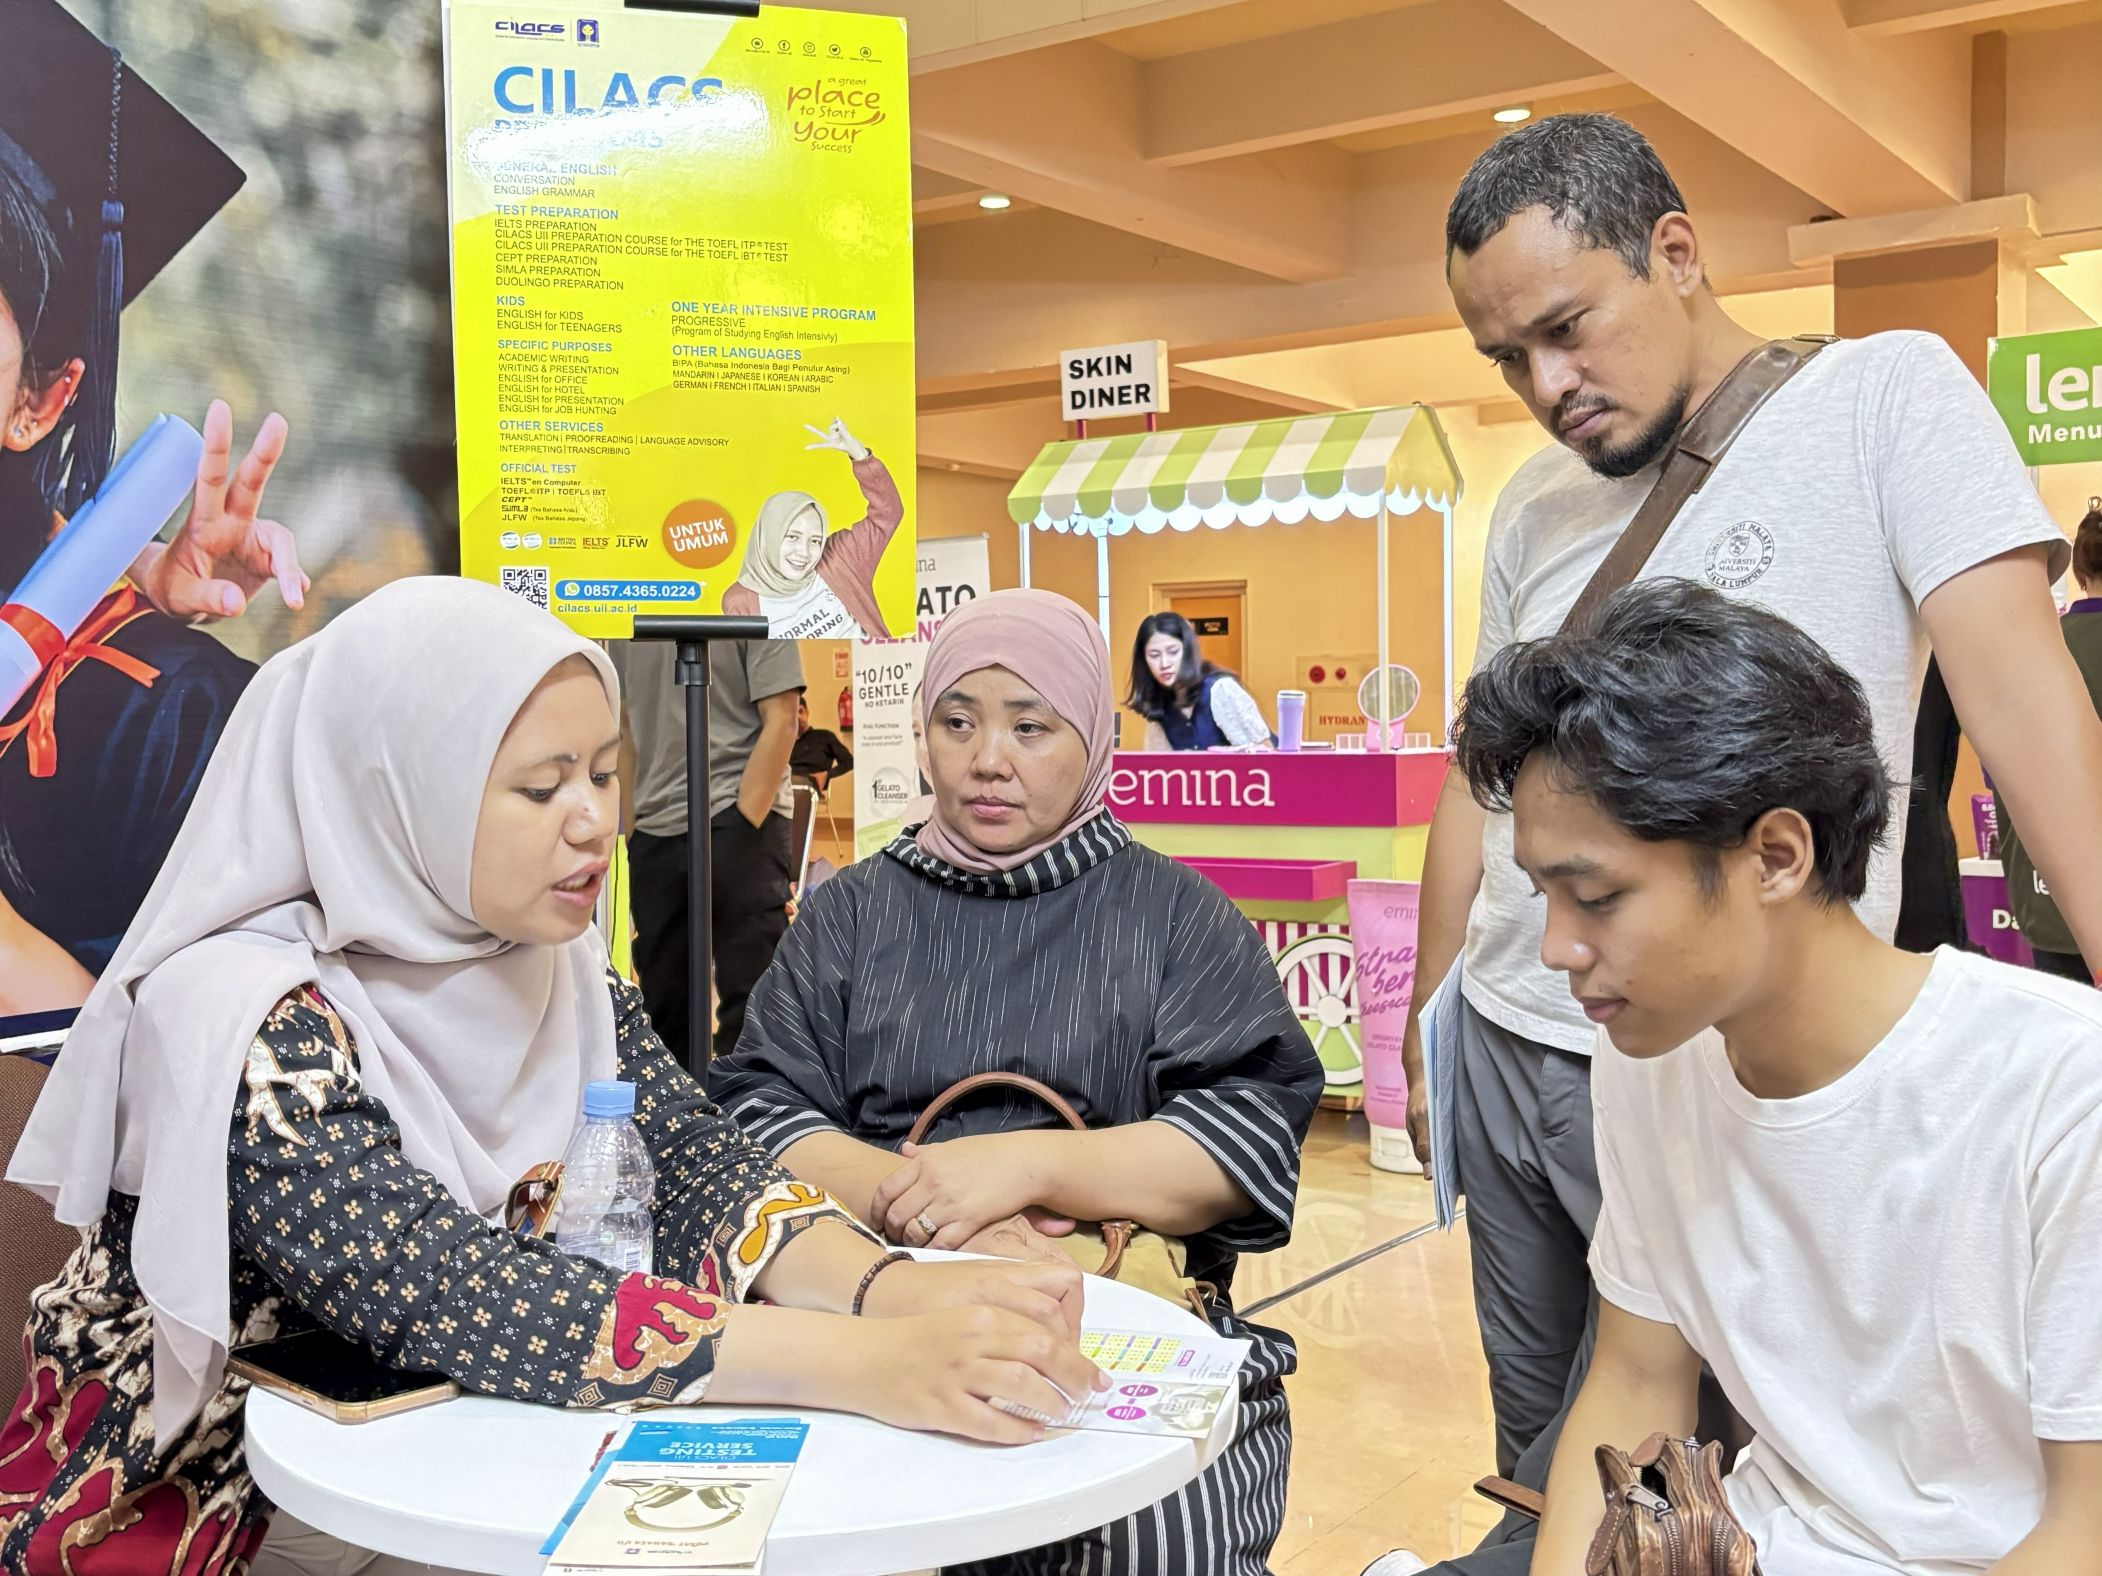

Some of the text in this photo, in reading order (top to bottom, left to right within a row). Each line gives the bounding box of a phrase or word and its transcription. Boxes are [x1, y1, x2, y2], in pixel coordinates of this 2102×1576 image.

[839, 77, 867, 87] great
[787, 79, 880, 111] place
[800, 105, 815, 116] to
[560, 163, 618, 176] ENGLISH
[494, 174, 576, 186] CONVERSATION
[494, 185, 596, 199] ENGLISH GRAMMAR
[495, 204, 619, 220] TEST PREPARATION
[494, 219, 597, 232] IELTS PREPARATION
[495, 228, 533, 240] CILACS
[535, 230, 549, 240] UII
[551, 231, 623, 244] PREPARATION
[625, 235, 668, 246] COURSE
[671, 237, 683, 247] for
[685, 237, 704, 248] THE
[706, 238, 739, 250] TOEFL
[764, 242, 789, 252] TEST
[495, 239, 533, 251] CILACS
[535, 241, 549, 251] UII
[551, 242, 623, 254] PREPARATION
[625, 246, 668, 257] COURSE
[671, 248, 683, 258] for
[685, 249, 704, 259] THE
[706, 249, 739, 260] TOEFL
[764, 252, 789, 262] TEST
[495, 252, 598, 266] CEPT PREPARATION
[495, 264, 601, 277] SIMLA PREPARATION
[495, 276, 624, 290] DUOLINGO PREPARATION
[496, 295, 525, 306] KIDS
[496, 308, 584, 321] ENGLISH for KIDS
[671, 301, 876, 321] ONE YEAR INTENSIVE PROGRAM
[497, 320, 623, 334] ENGLISH for TEENAGERS
[671, 315, 746, 328] PROGRESSIVE
[671, 325, 712, 337] (Program
[713, 328, 722, 336] of
[724, 328, 761, 340] Studying
[763, 329, 794, 340] English
[498, 339, 613, 353] SPECIFIC PURPOSES
[672, 345, 802, 360] OTHER LANGUAGES
[498, 353, 590, 364] ACADEMIC WRITING
[672, 359, 693, 367] BIPA
[694, 360, 729, 369] (Bahasa
[731, 361, 770, 370] Indonesia
[498, 363, 619, 375] WRITING & PRESENTATION
[1069, 353, 1132, 379] SKIN
[498, 373, 588, 384] ENGLISH for OFFICE
[672, 370, 834, 383] MANDARIN JAPANESE KOREAN ARABIC
[498, 383, 585, 394] ENGLISH for HOTEL
[672, 380, 821, 393] GERMAN FRENCH ITALIAN SPANISH
[499, 394, 624, 405] ENGLISH for PRESENTATION
[1071, 383, 1151, 410] DINER
[499, 404, 617, 415] ENGLISH for JOB HUNTING
[499, 420, 604, 432] OTHER SERVICES
[500, 433, 730, 446] TRANSLATION PROOFREADING LANGUAGE ADVISORY
[499, 445, 631, 455] INTERPRETING TRANSCRIBING
[500, 463, 577, 474] OFFICIAL TEST
[543, 479, 581, 487] Computer
[669, 517, 727, 539] UNTUK
[616, 538, 648, 548] JLFW
[673, 531, 729, 553] UMUM
[583, 584, 696, 597] 0857.4365.0224
[859, 683, 909, 700] GENTLE
[1108, 768, 1276, 807] emina
[659, 1447, 757, 1456] TESTING
[670, 1441, 753, 1449] SERVICE
